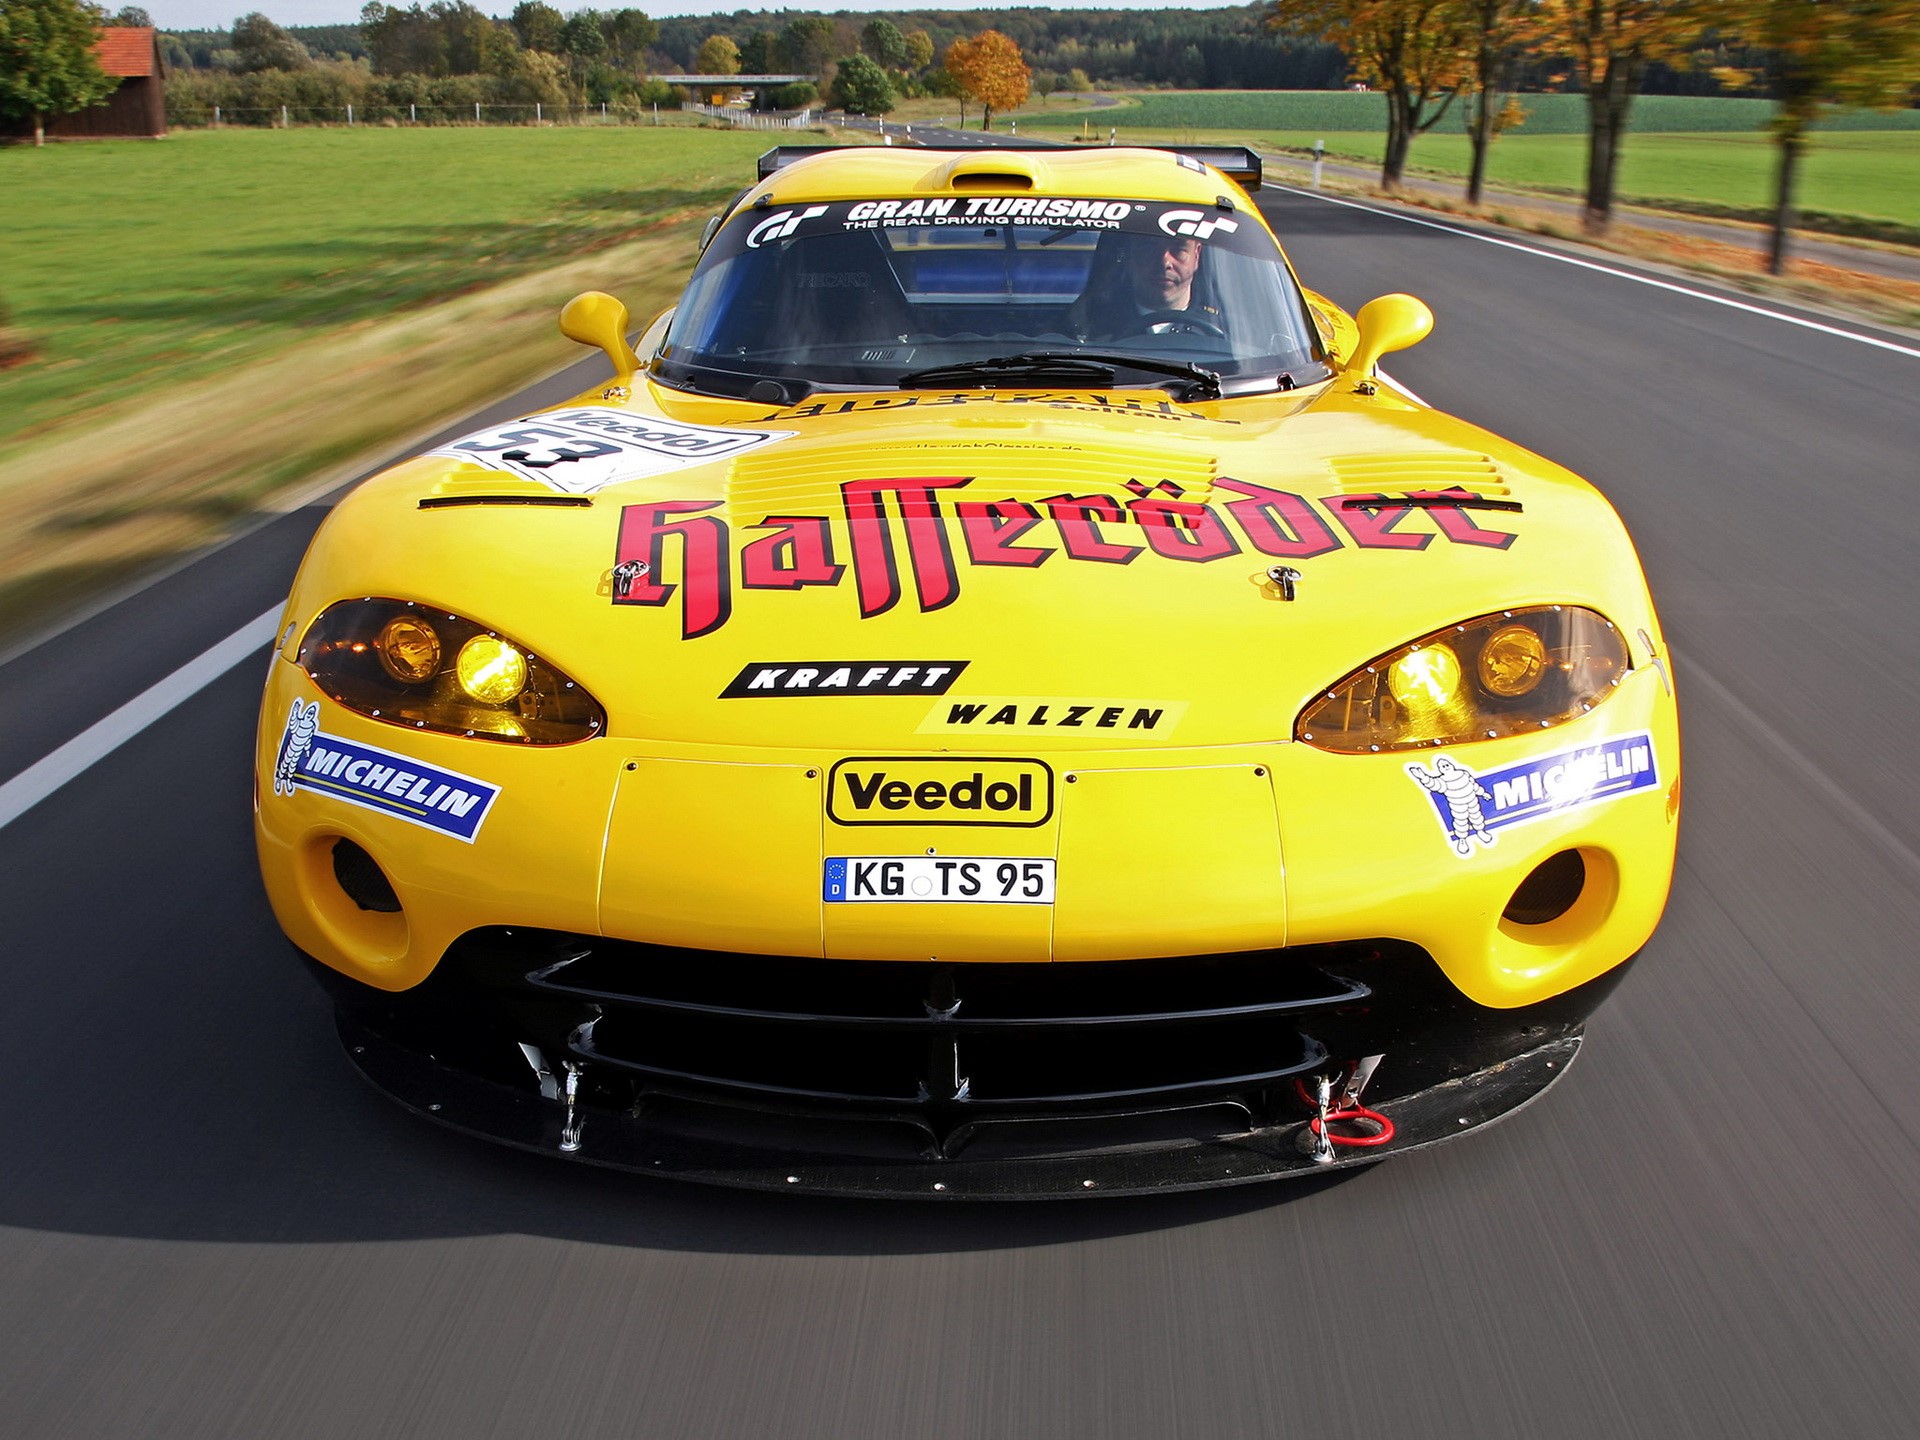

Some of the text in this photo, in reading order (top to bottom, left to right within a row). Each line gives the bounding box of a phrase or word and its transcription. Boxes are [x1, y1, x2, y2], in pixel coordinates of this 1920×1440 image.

[842, 216, 1121, 230] THE REAL DRIVING SIMULATOR
[847, 198, 957, 222] GRAN
[796, 272, 872, 289] RECARO
[554, 412, 738, 451] Veedol
[453, 428, 623, 468] 53
[746, 666, 952, 690] KRAFFT
[946, 703, 1164, 730] WALZEN
[305, 747, 481, 818] MICHELIN
[844, 772, 1032, 812] Veedol
[831, 862, 1044, 897] D KG TS 95
